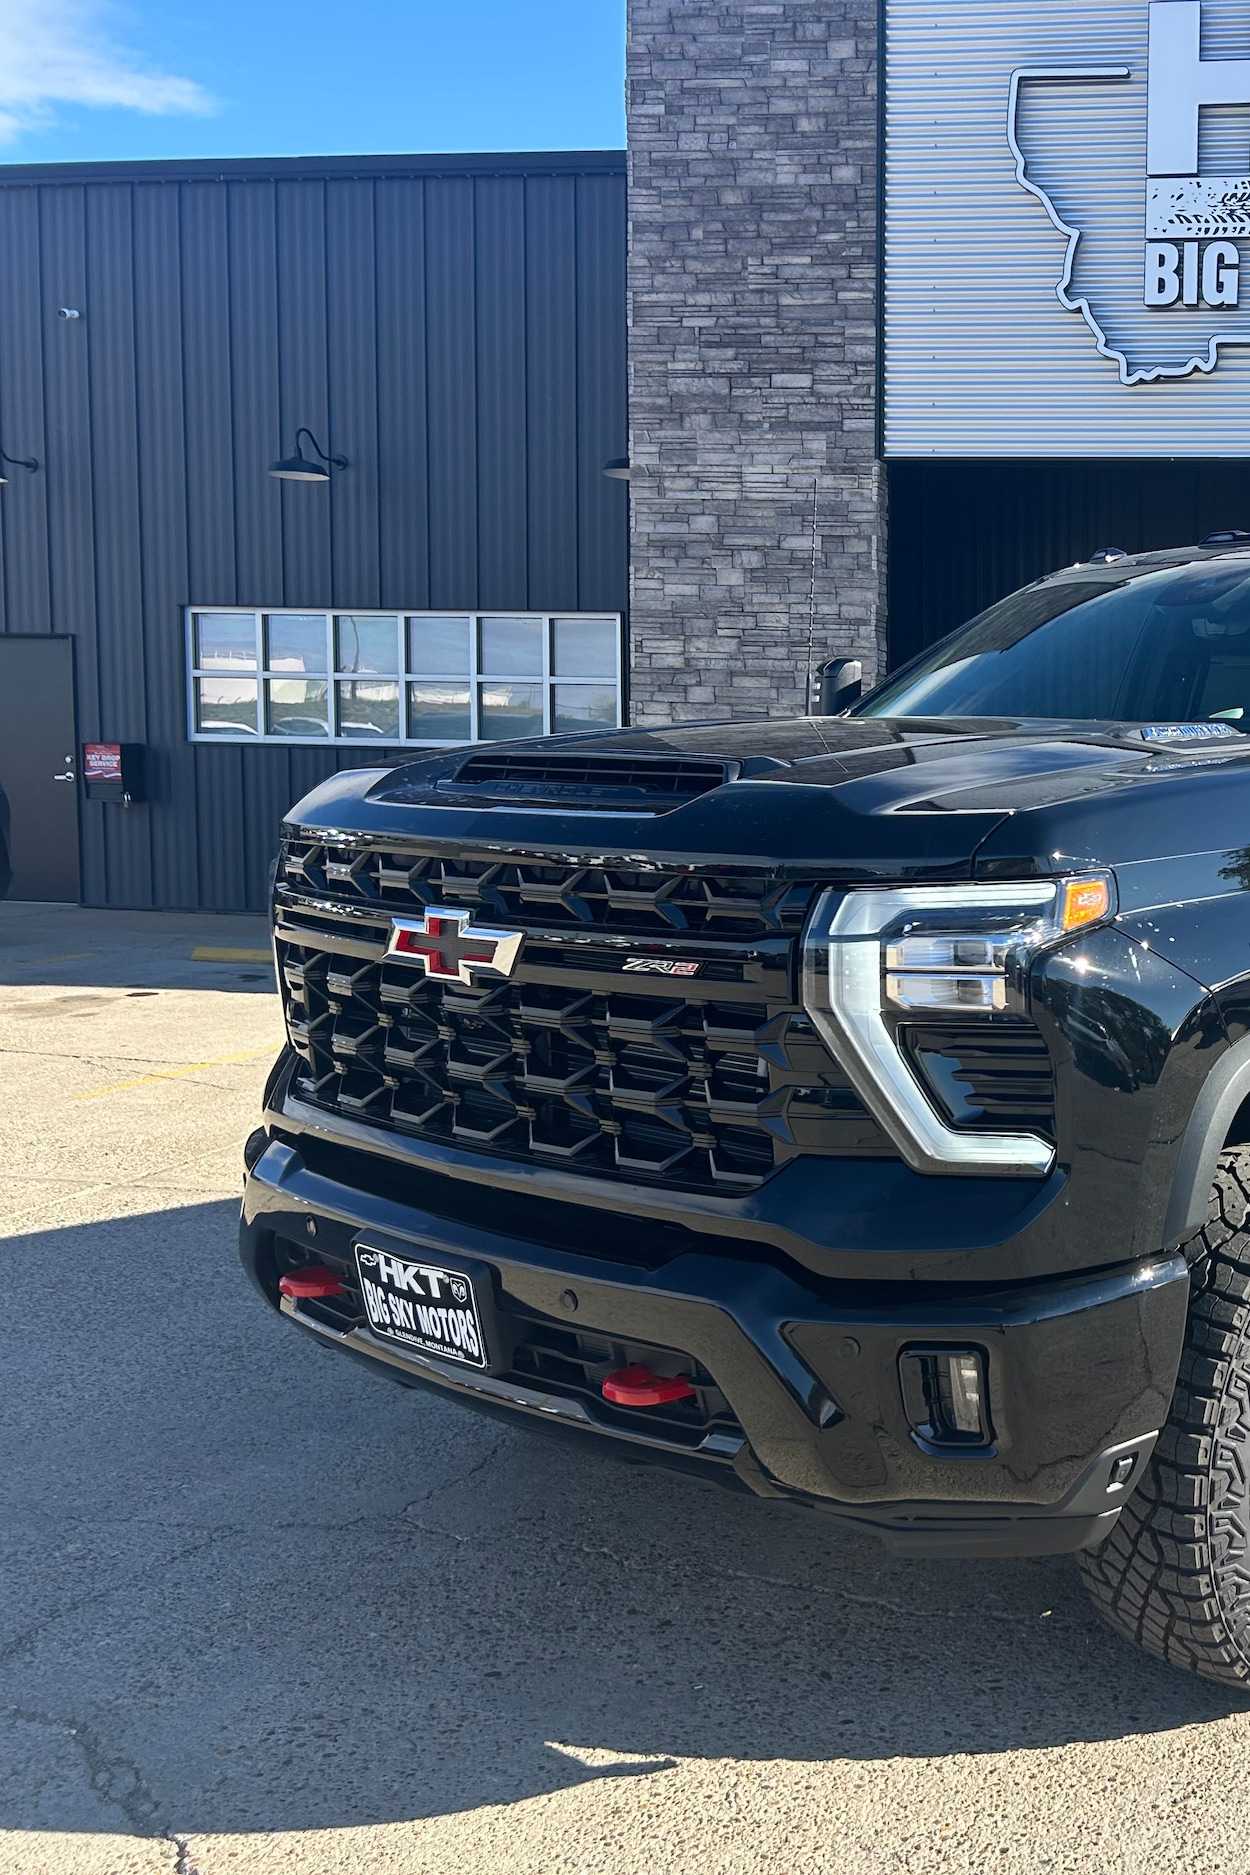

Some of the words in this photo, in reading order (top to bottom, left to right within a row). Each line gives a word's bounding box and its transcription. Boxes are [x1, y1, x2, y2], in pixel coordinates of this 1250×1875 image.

[1143, 241, 1241, 307] BIG
[622, 957, 699, 976] ZR2
[378, 1253, 444, 1299] HKT
[363, 1277, 391, 1325] BIG
[387, 1292, 417, 1331] SKY
[415, 1304, 480, 1357] MOTORS
[424, 1340, 458, 1356] MONTANA
